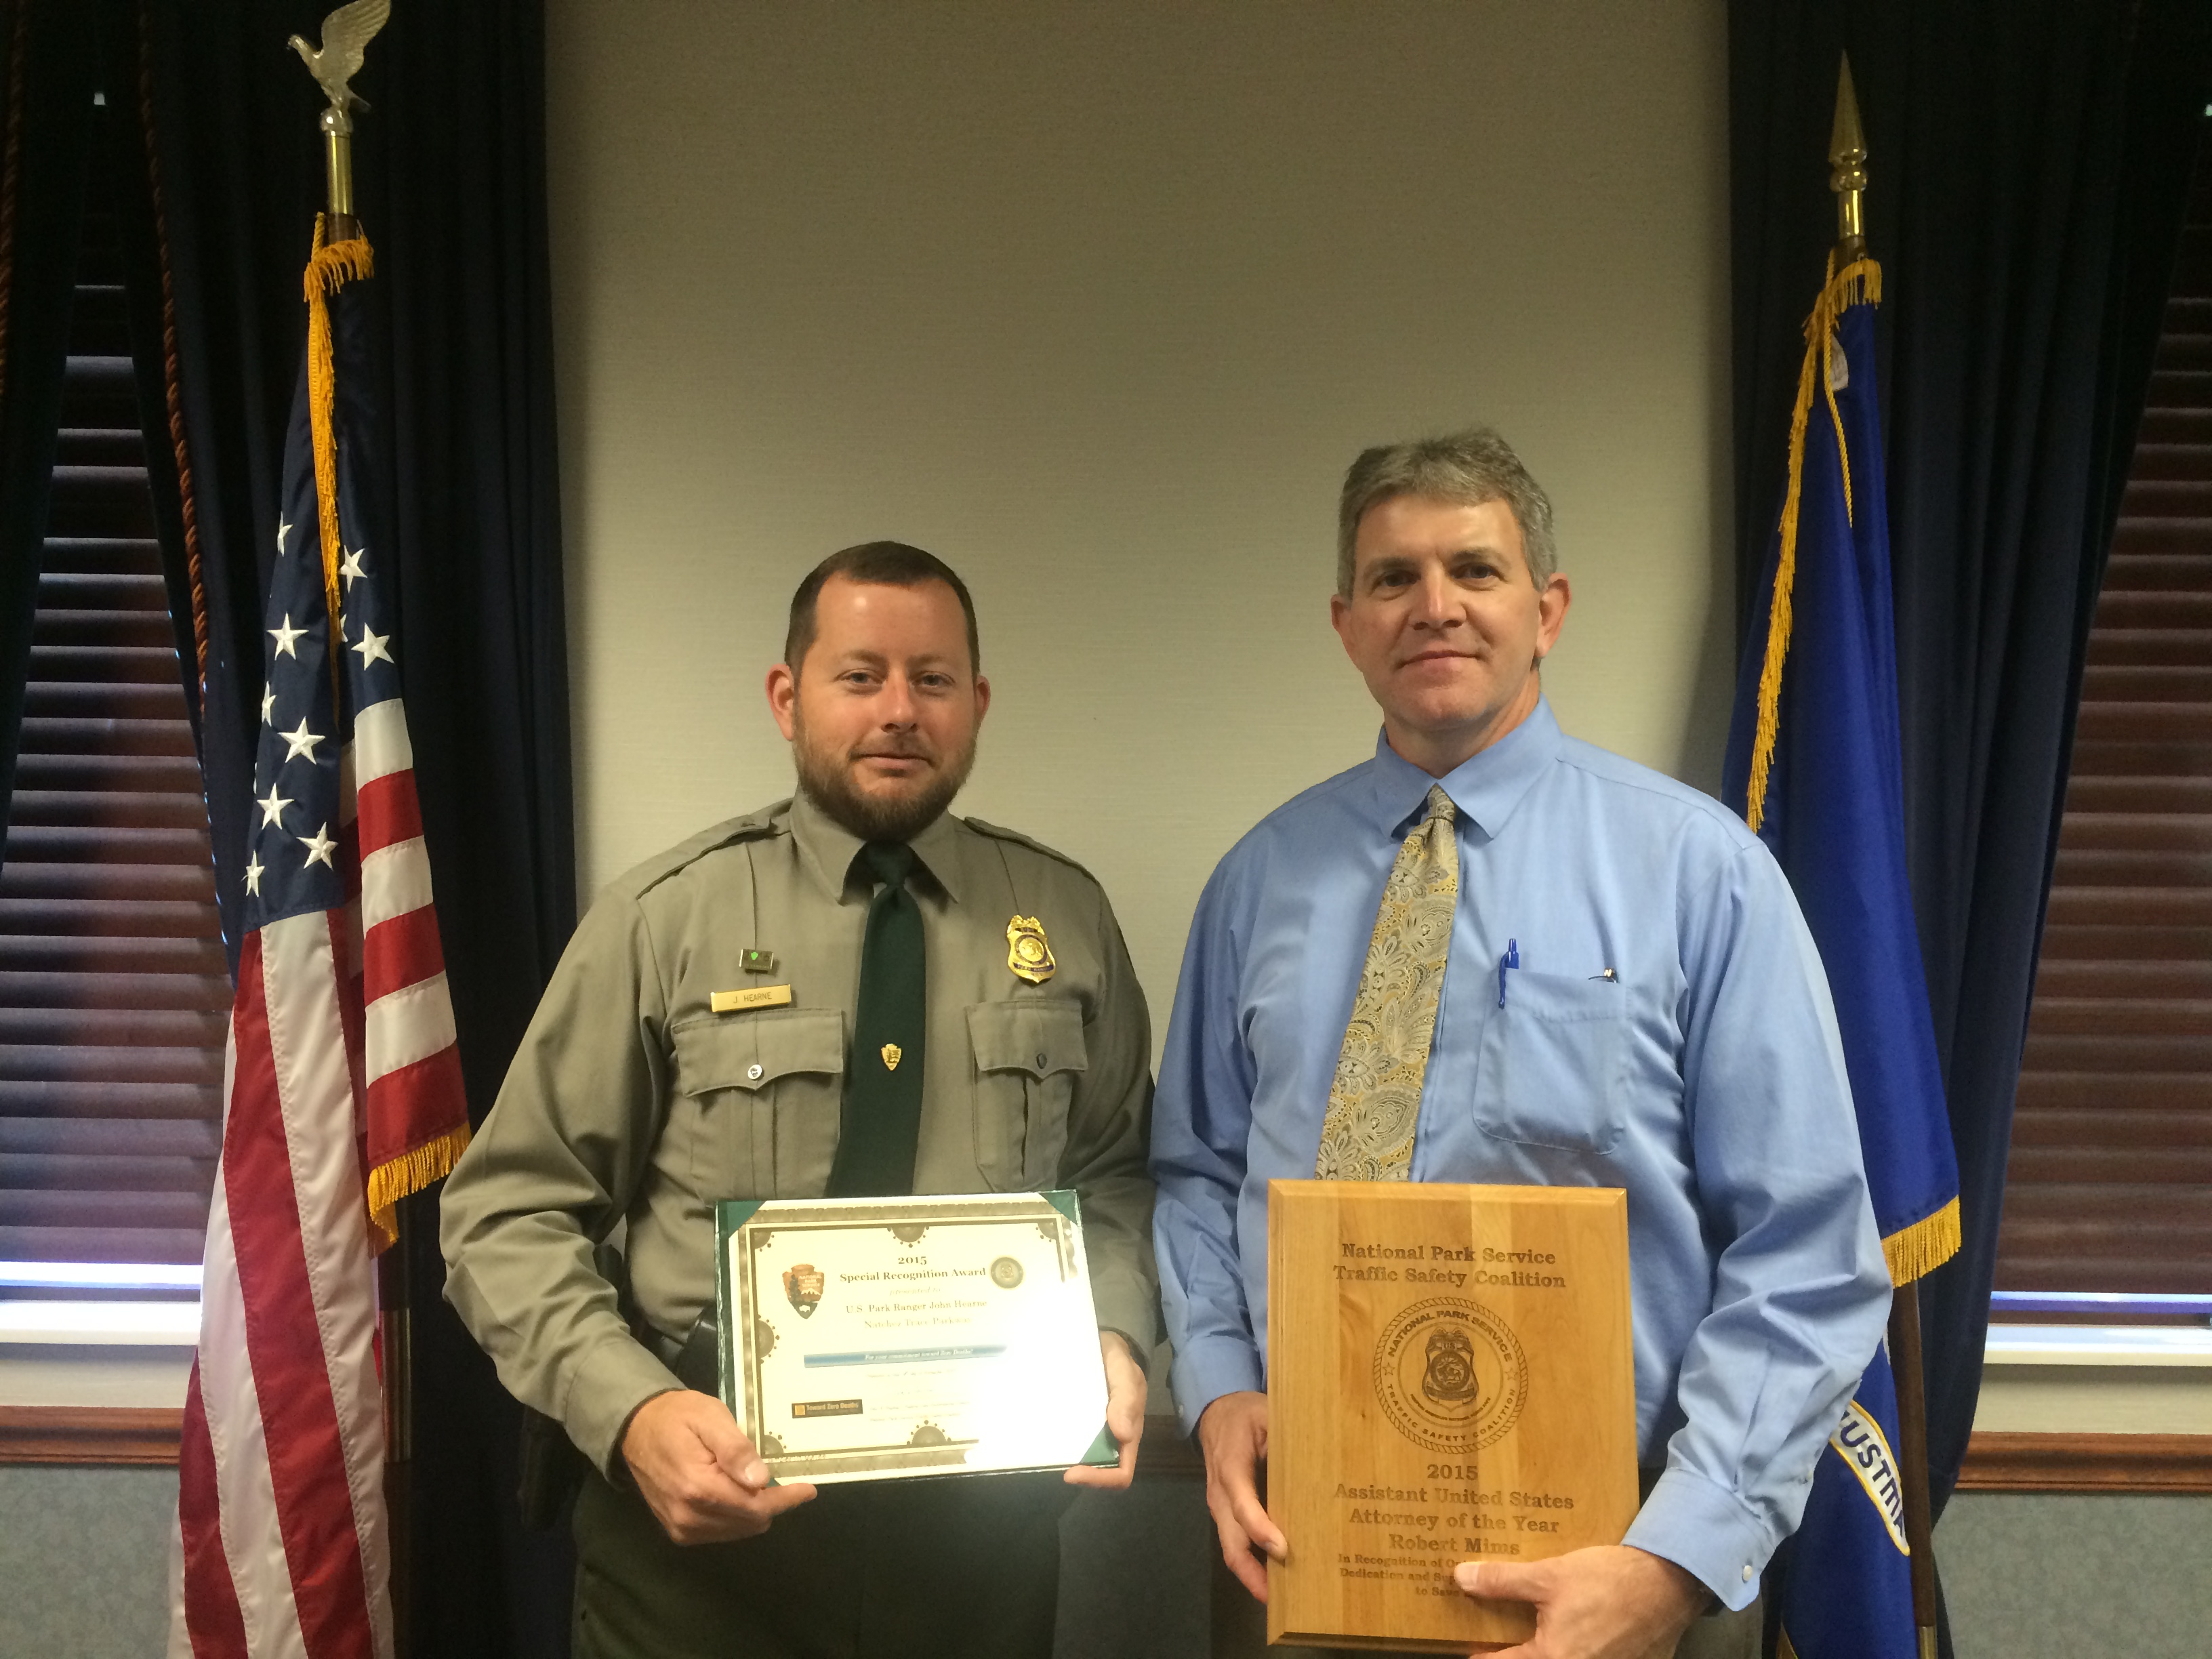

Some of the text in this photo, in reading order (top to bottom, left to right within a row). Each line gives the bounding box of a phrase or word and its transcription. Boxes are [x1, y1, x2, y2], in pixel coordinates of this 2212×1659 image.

[743, 991, 773, 1002] HEARNE
[898, 1256, 927, 1265] 2015
[1342, 1244, 1556, 1265] National Park Service
[840, 1267, 986, 1284] Special Recognition Award
[1333, 1265, 1566, 1288] Traffic Safety Coalition
[890, 1286, 930, 1296] presented
[869, 1304, 890, 1313] Park
[894, 1303, 926, 1312] Ranger
[929, 1301, 951, 1309] John
[955, 1300, 987, 1308] Hearne
[864, 1320, 901, 1329] Natchez
[933, 1316, 971, 1326] Parkway
[1388, 1310, 1513, 1362] NATIONAL PARK SERVICE
[1387, 1384, 1515, 1441] TRAFFIC SAFETY COALITION
[1427, 1463, 1479, 1480] 2015
[1334, 1483, 1574, 1510] Assistant United States
[1349, 1508, 1560, 1533] Attorney of the Year
[1389, 1534, 1520, 1555] Robert Mims
[1338, 1553, 1351, 1563] In
[1355, 1553, 1426, 1568] Recognition
[1431, 1557, 1443, 1568] of
[1340, 1568, 1404, 1580] Dedication
[1408, 1572, 1429, 1582] and
[1416, 1586, 1429, 1595] to
[1432, 1586, 1459, 1597] Save
